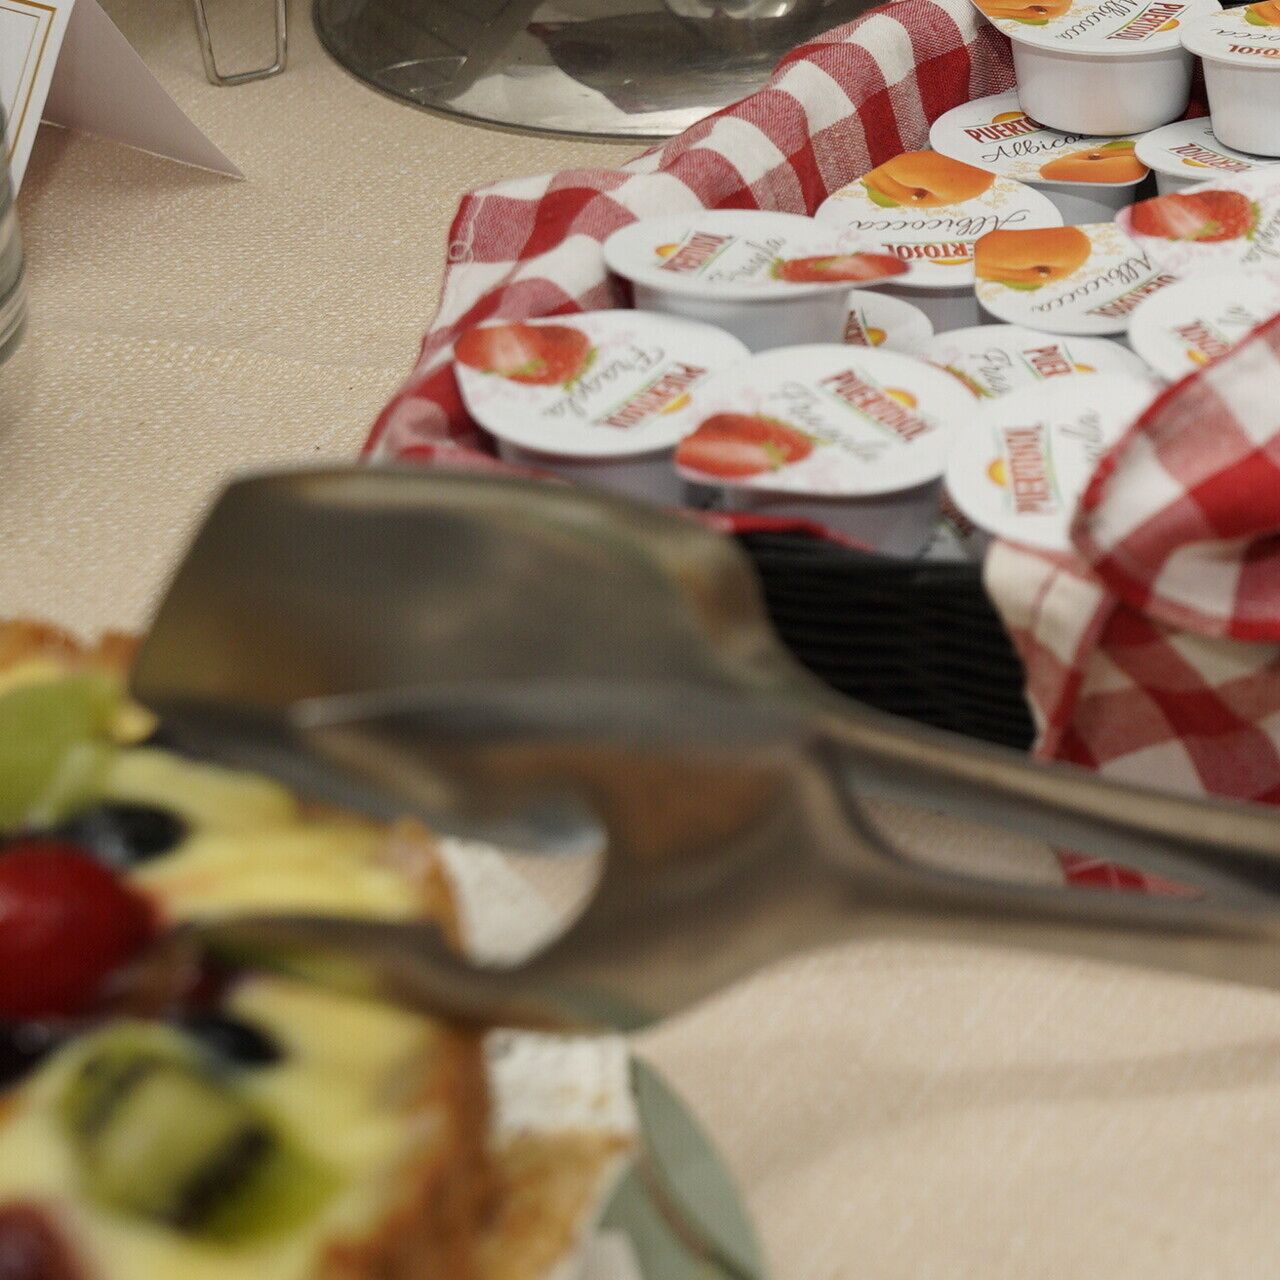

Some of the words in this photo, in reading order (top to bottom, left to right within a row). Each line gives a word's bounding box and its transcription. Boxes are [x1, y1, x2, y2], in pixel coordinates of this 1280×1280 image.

[1105, 1, 1186, 41] PUERTOSOL
[1028, 248, 1158, 315] Albicocca
[817, 366, 937, 443] PUERTOSOL
